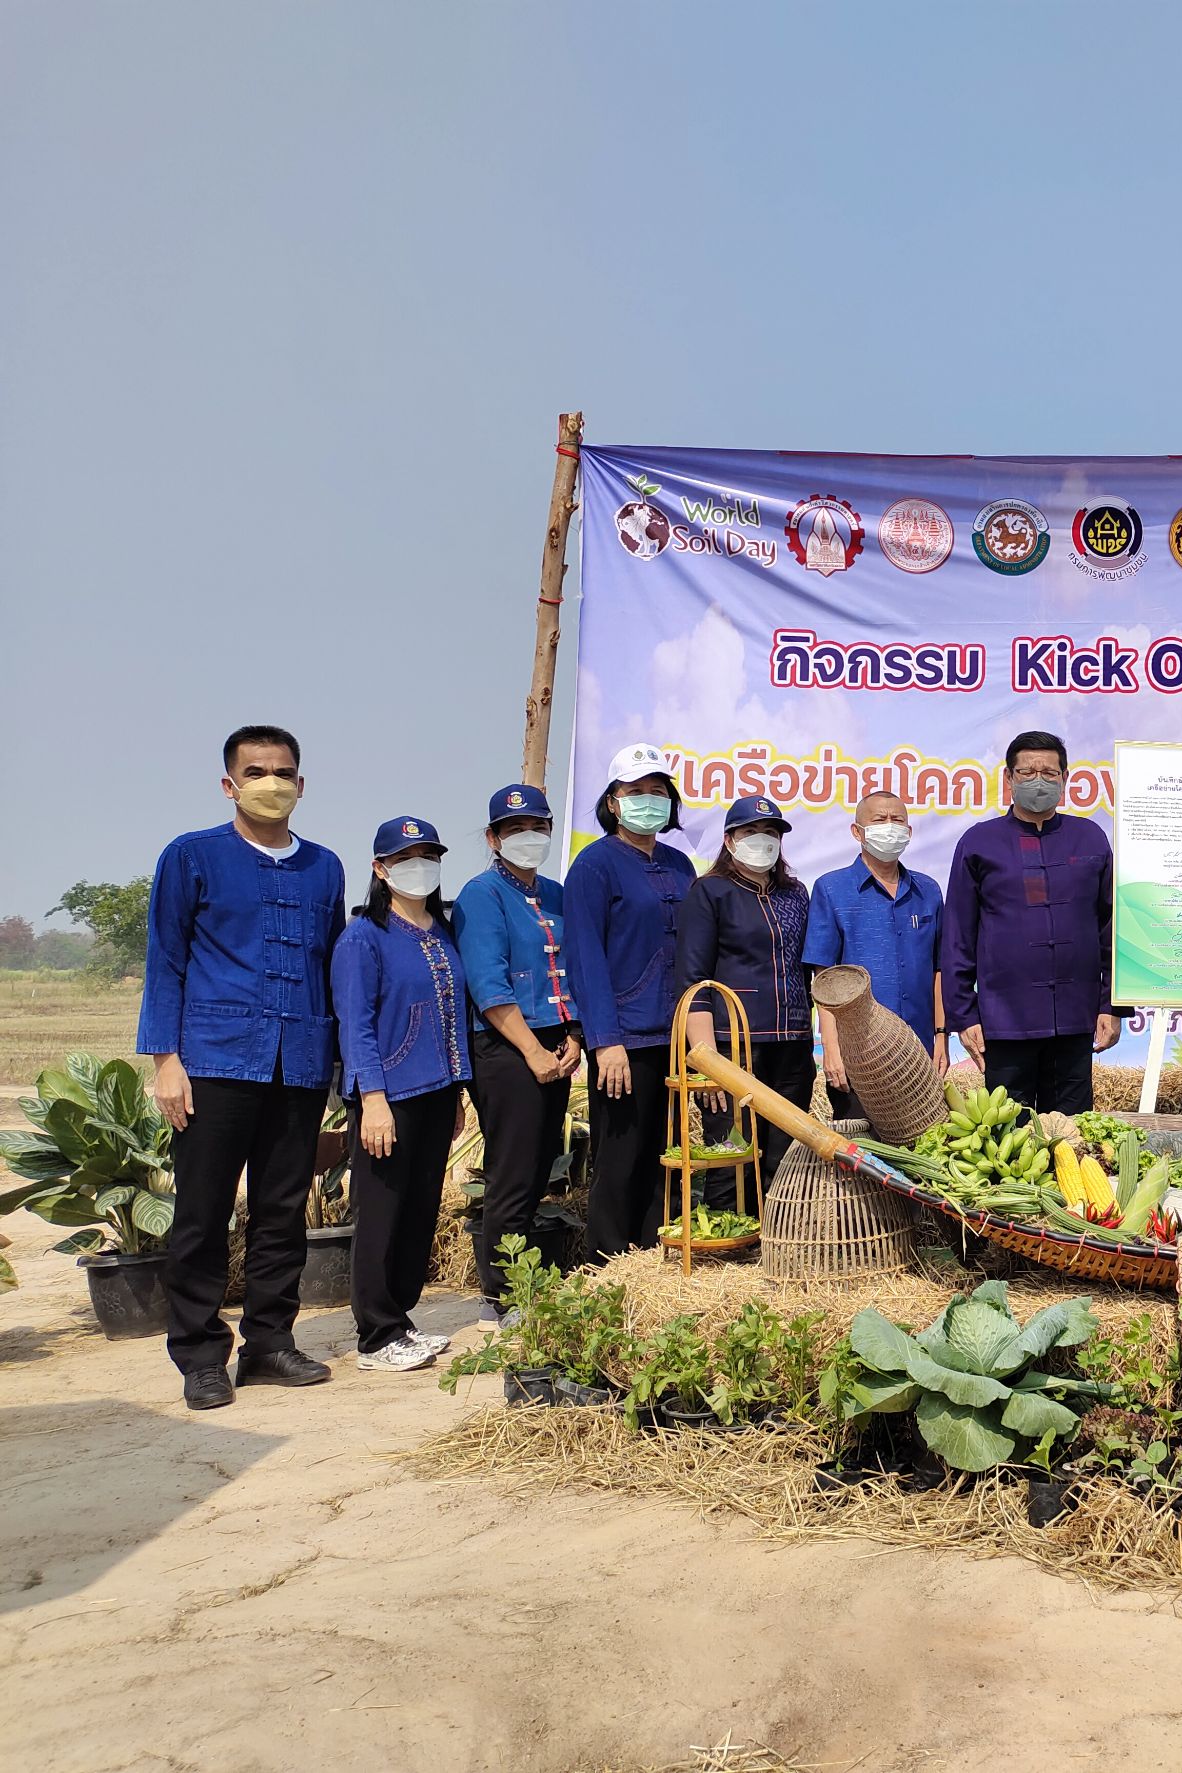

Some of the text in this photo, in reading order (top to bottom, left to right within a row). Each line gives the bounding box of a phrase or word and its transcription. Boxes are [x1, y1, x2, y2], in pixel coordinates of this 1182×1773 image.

[680, 496, 760, 527] World
[671, 525, 777, 567] Soil Day
[775, 633, 981, 688] กิจกรรม
[1017, 640, 1133, 688] Kick
